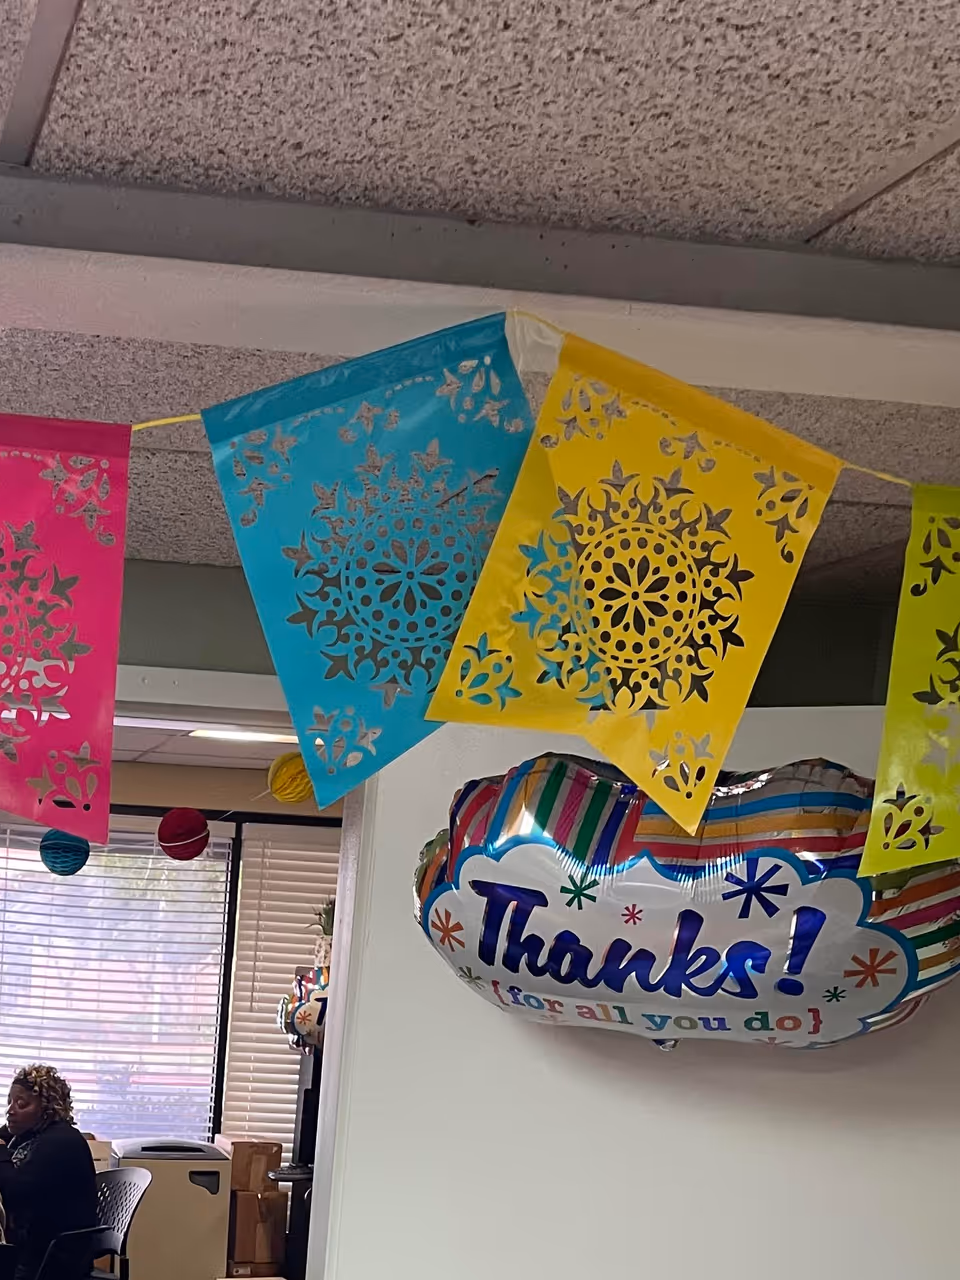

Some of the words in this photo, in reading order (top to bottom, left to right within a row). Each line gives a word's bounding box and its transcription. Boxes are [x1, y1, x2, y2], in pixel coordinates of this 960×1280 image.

[468, 879, 827, 999] Thanks!
[575, 1001, 634, 1026] all
[641, 1012, 732, 1033] you
